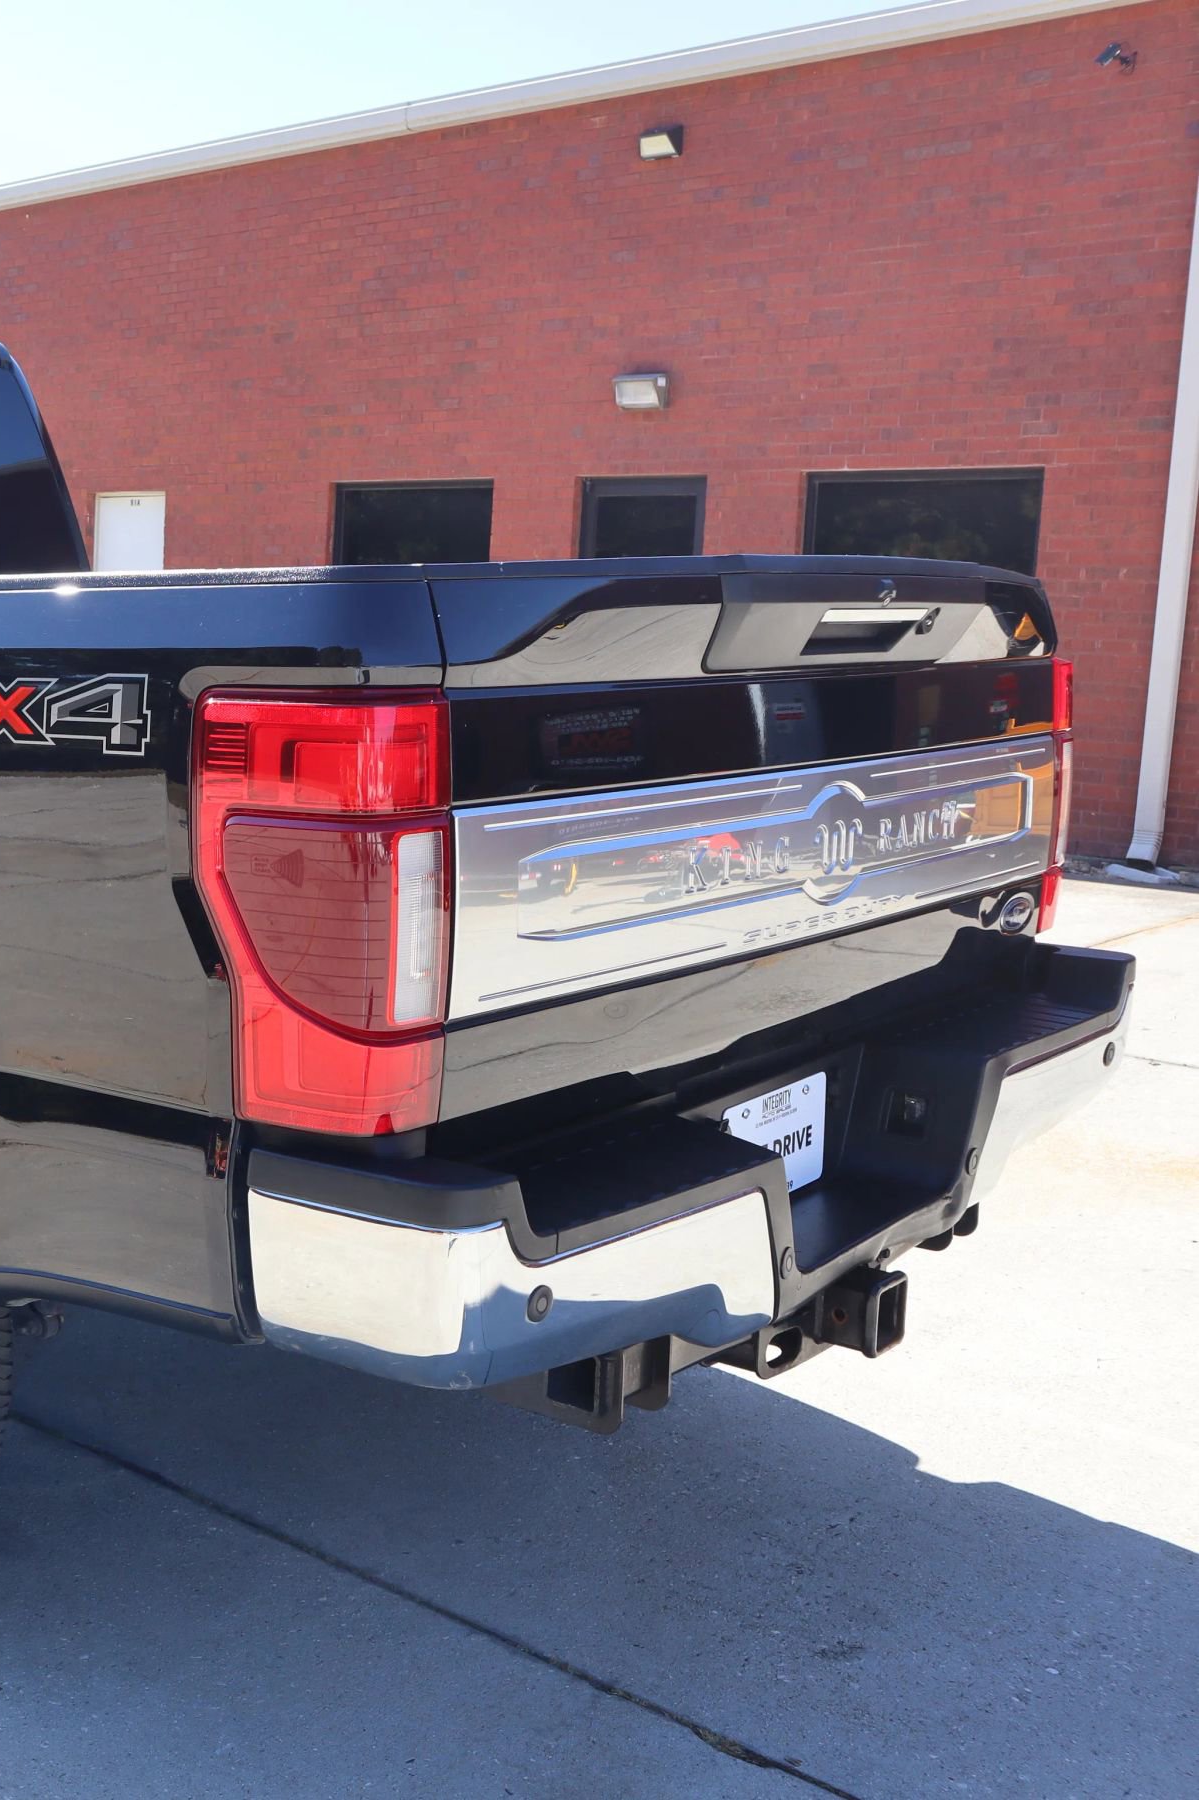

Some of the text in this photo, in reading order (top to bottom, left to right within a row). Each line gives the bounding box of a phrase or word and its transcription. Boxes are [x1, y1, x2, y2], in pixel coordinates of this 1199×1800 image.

[682, 834, 790, 895] KING
[876, 802, 962, 852] RANCH
[742, 910, 838, 945] SUPER
[762, 1088, 792, 1113] INTEGRITY
[773, 1124, 812, 1157] DRIVE
